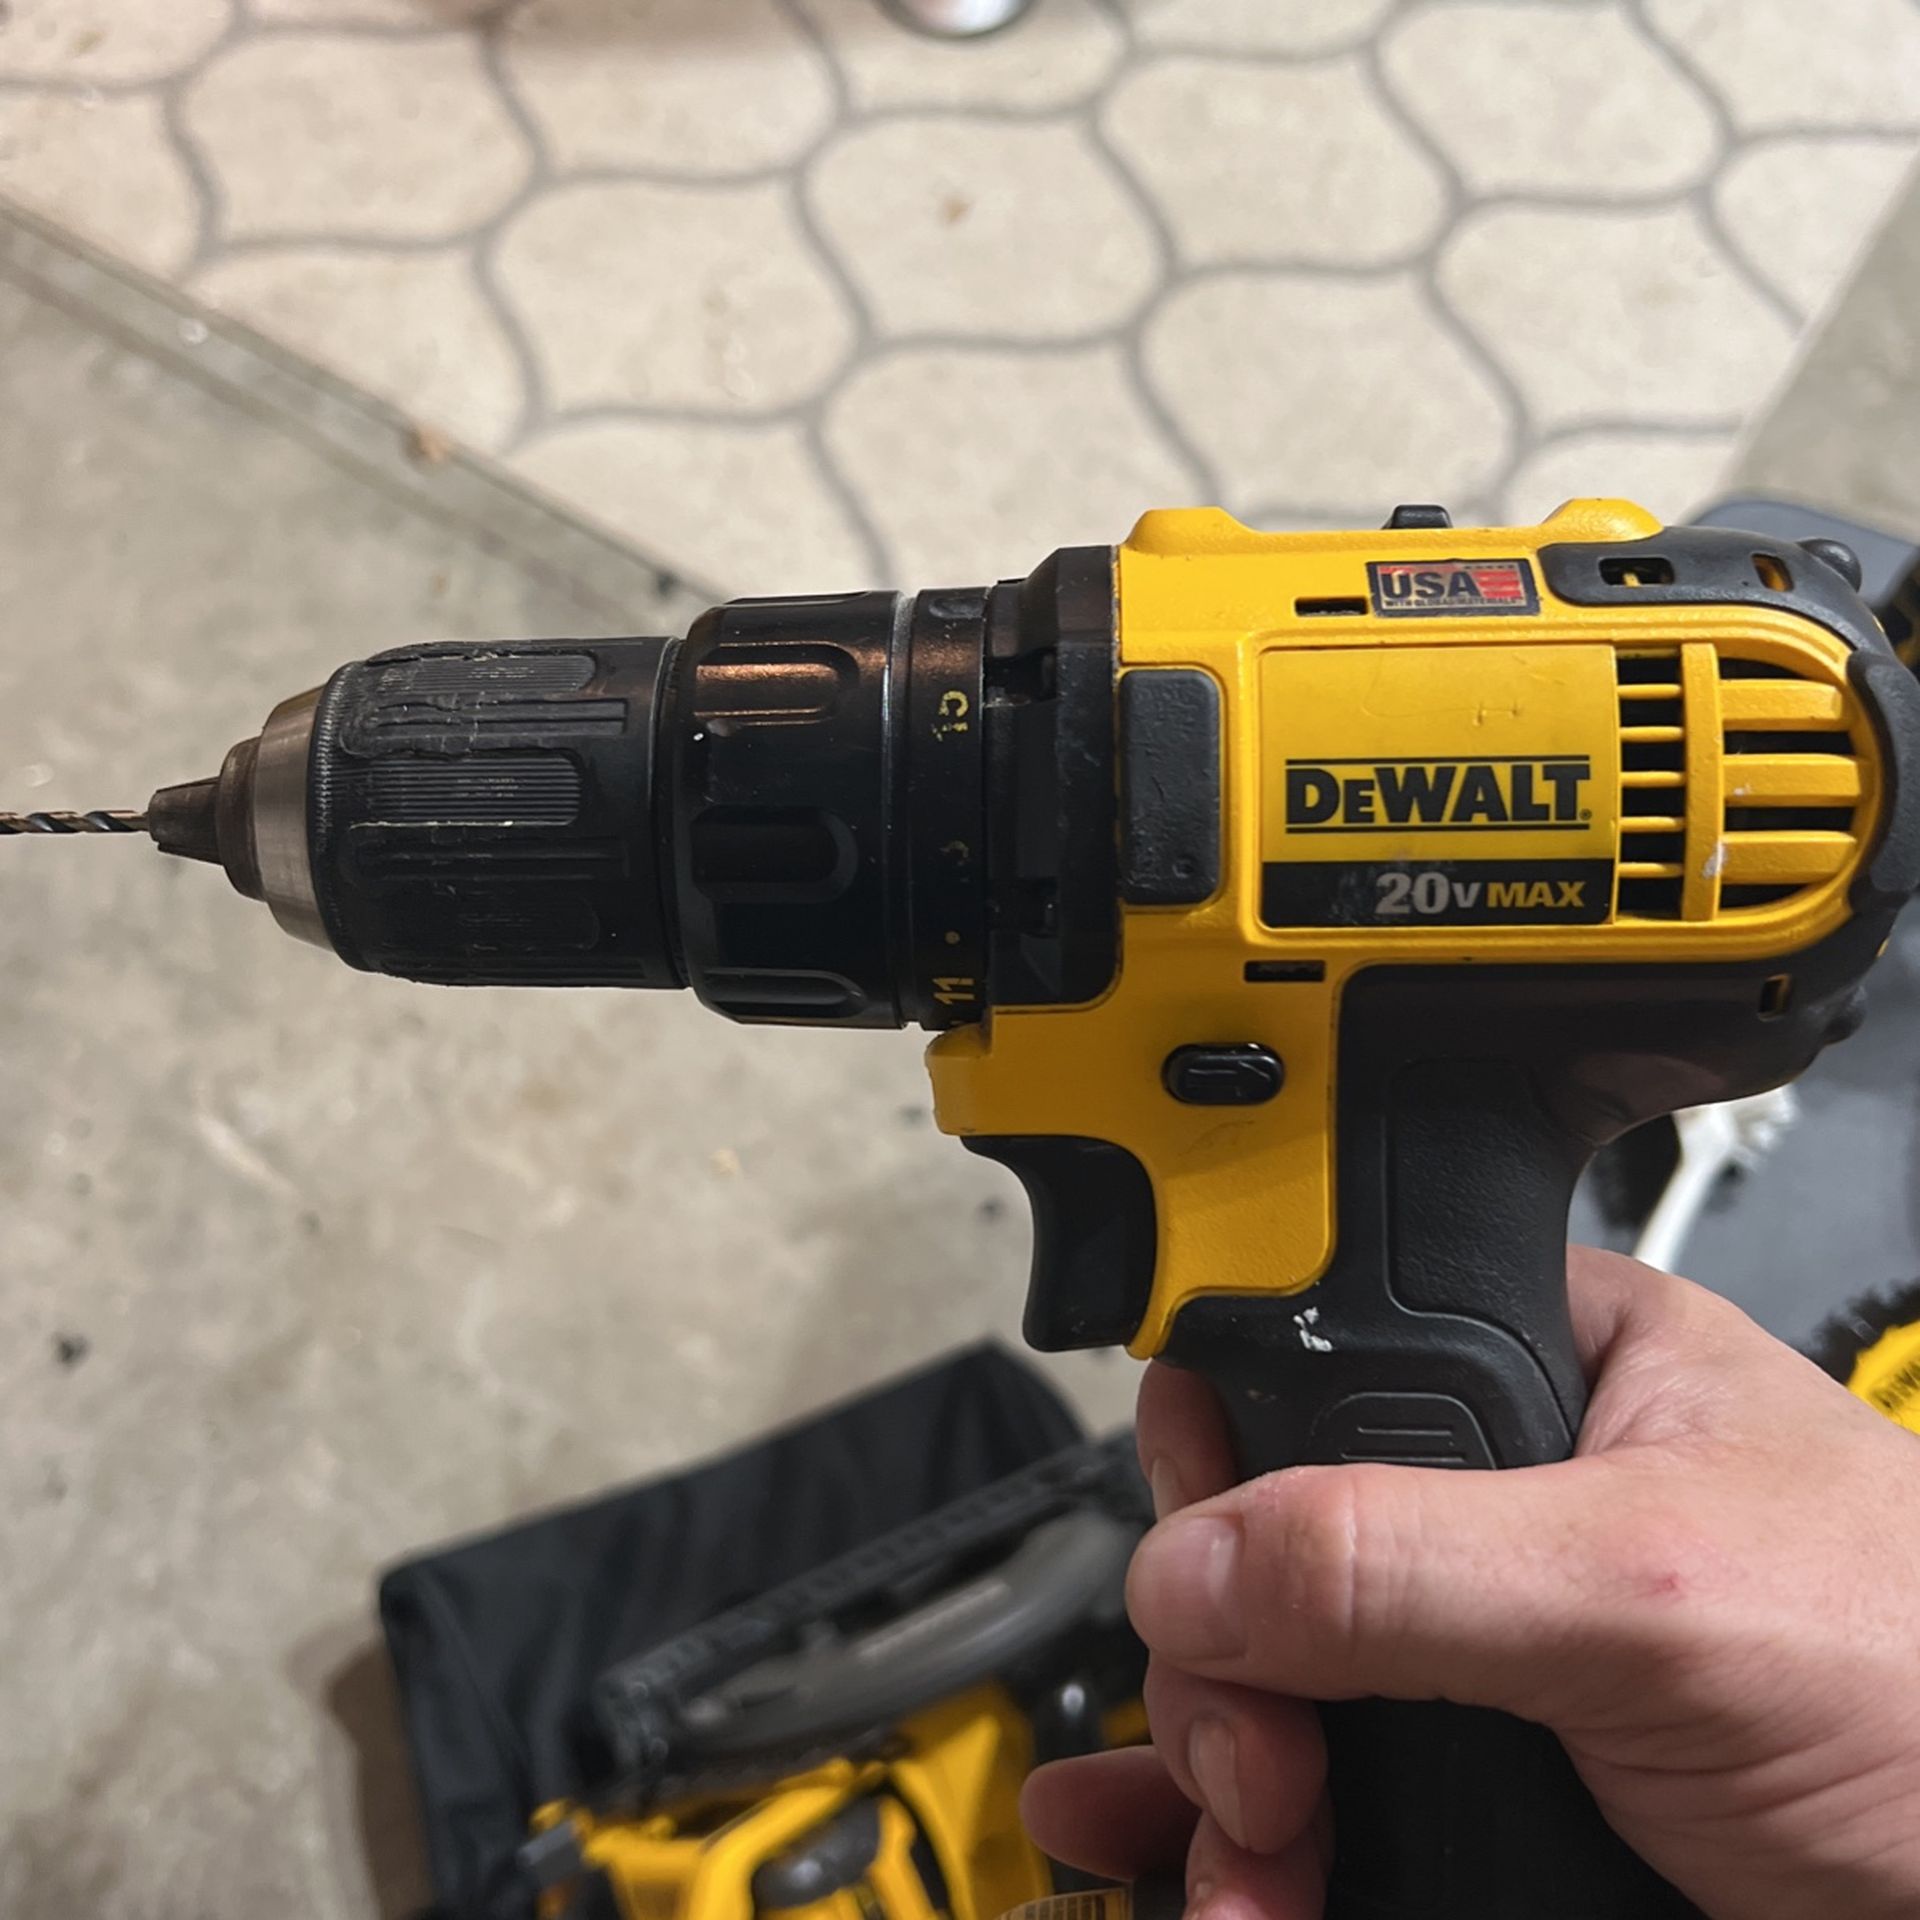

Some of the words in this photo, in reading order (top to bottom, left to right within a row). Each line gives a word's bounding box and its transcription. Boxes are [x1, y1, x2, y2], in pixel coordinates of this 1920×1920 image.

[1382, 571, 1483, 599] USA
[1487, 881, 1586, 908] MAX
[931, 977, 975, 1005] 11
